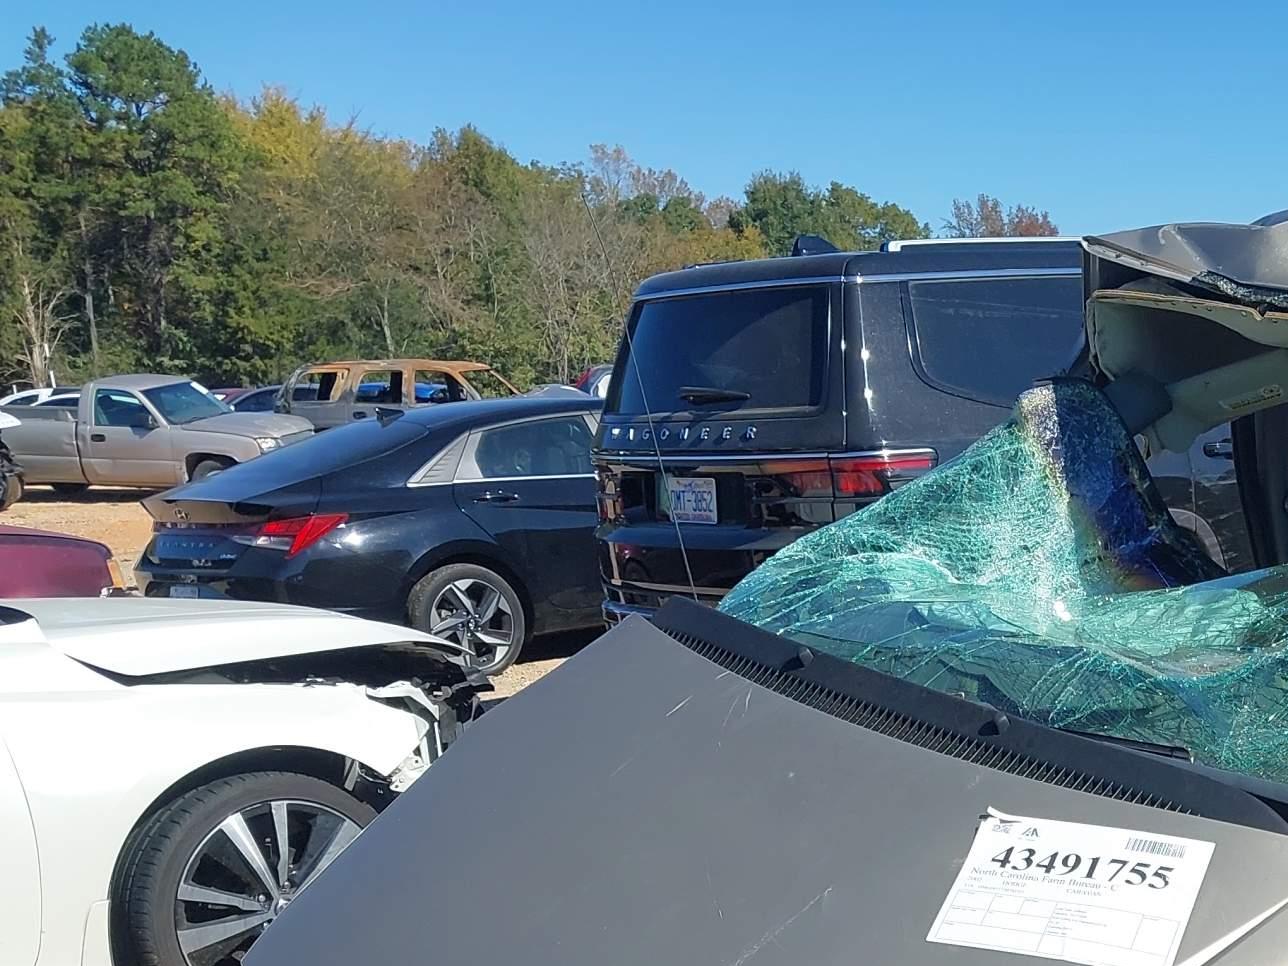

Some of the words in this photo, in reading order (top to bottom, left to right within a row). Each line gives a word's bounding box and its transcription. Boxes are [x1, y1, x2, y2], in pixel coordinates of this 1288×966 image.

[611, 427, 757, 441] WAGONEER
[970, 867, 998, 877] North
[1000, 870, 1039, 881] Carolina
[1041, 875, 1066, 886] Farm
[1068, 879, 1102, 890] Bureau
[991, 845, 1175, 890] 43491755
